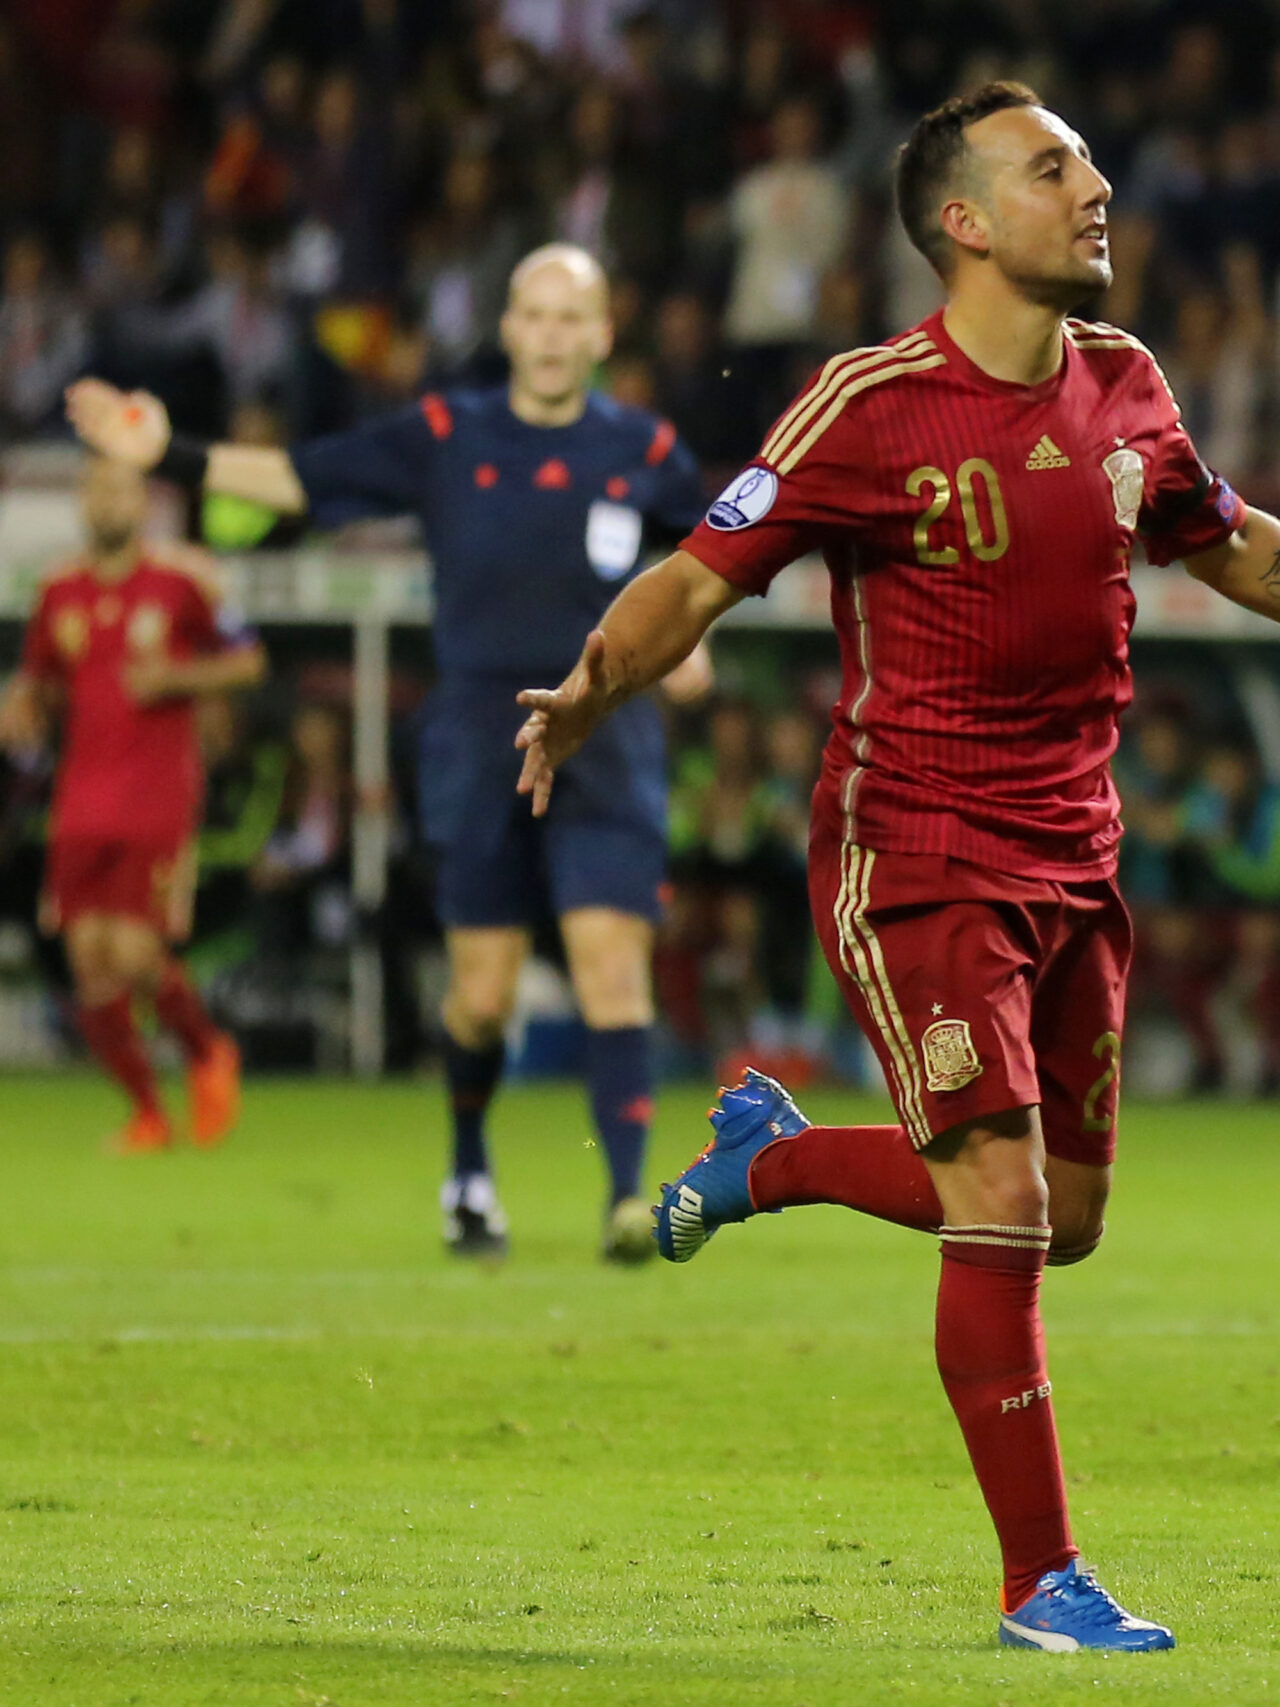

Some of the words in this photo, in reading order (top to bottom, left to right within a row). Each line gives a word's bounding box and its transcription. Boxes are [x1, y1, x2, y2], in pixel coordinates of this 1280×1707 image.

[1025, 455, 1071, 471] adidas
[905, 457, 1010, 562] 20
[1082, 1031, 1121, 1132] 2
[1001, 1380, 1052, 1414] RFE
